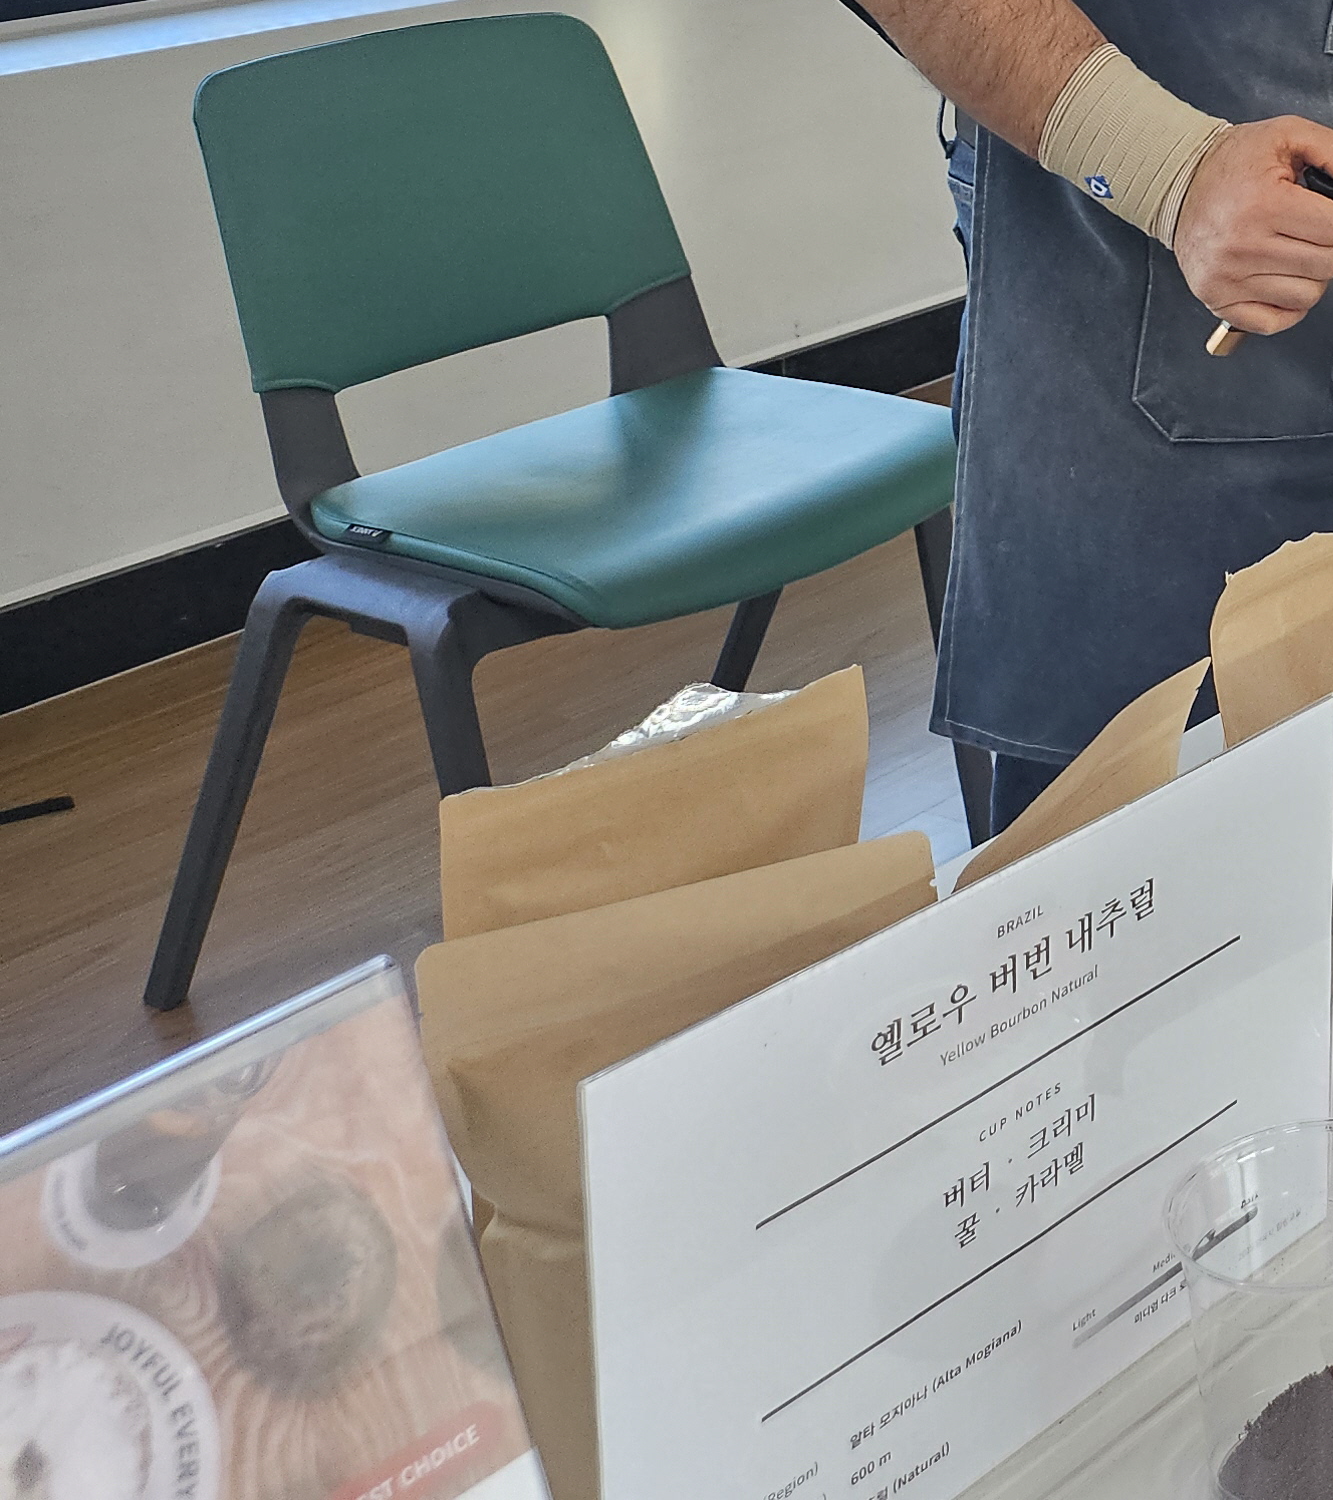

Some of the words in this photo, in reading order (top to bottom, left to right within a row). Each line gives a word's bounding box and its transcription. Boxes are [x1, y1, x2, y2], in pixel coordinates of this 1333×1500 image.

[996, 904, 1045, 939] BRAZIL
[871, 983, 978, 1067] 옐로우
[989, 935, 1053, 993] 버번
[1065, 877, 1156, 953] 내추럴
[939, 1033, 985, 1067] Yellow
[990, 998, 1048, 1040] Bourbon
[1051, 964, 1099, 1003] Natural
[979, 1117, 1007, 1142] CUP
[1014, 1082, 1062, 1121] NOTES
[942, 1160, 990, 1208] 버터
[1027, 1093, 1096, 1159] 크리미
[954, 1211, 981, 1249] 꿀
[1015, 1141, 1084, 1208] 카라멜
[1071, 1308, 1097, 1332] Light
[100, 1322, 183, 1402] JOYFUL
[849, 1421, 876, 1450] 알타
[879, 1385, 929, 1430] 모지아나
[932, 1362, 962, 1393] (Alta
[965, 1319, 1023, 1369] Mogiana)
[400, 1423, 481, 1488] CHOICE
[850, 1460, 876, 1486] 600
[878, 1451, 892, 1467] m
[893, 1441, 951, 1494] (Natural)
